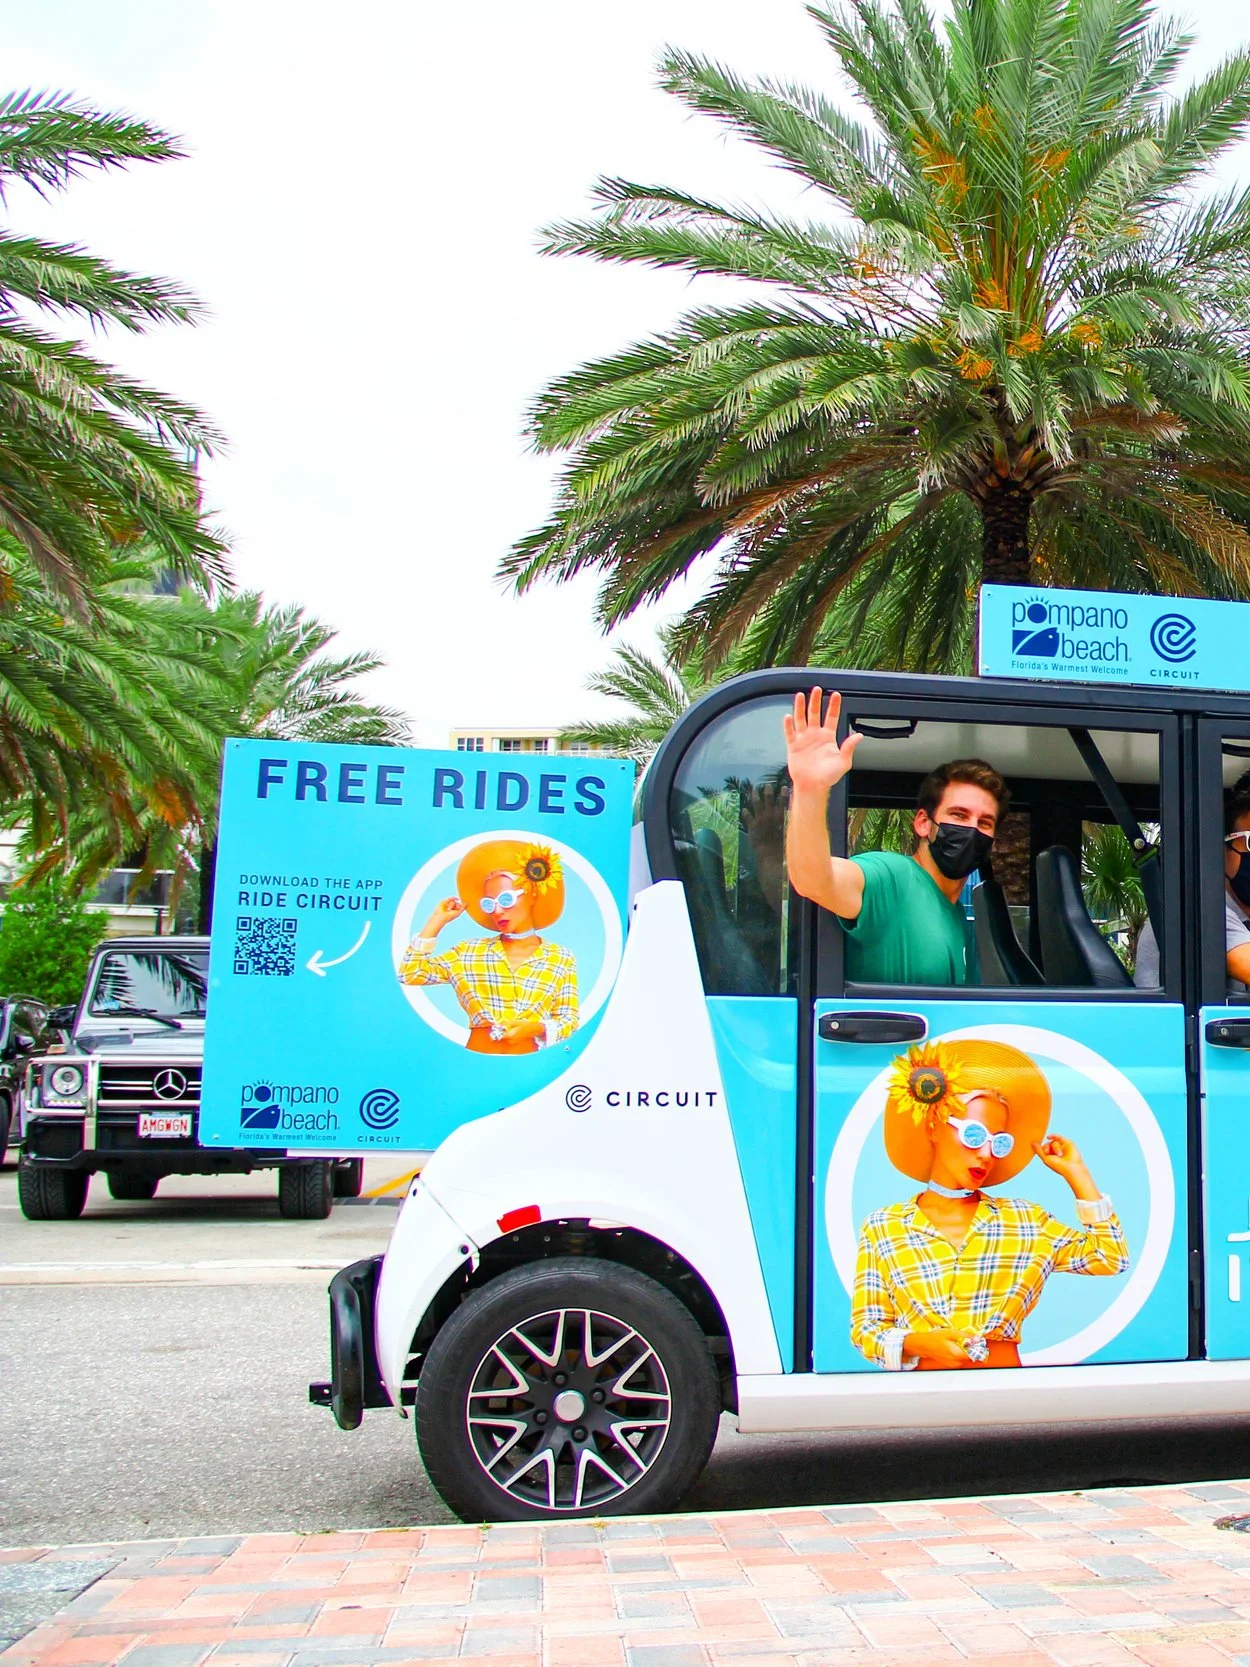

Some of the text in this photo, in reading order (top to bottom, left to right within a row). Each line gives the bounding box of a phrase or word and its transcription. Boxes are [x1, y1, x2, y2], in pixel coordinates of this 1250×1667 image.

[1012, 601, 1128, 631] pompano
[1061, 632, 1129, 662] beach
[1011, 661, 1128, 675] Florida's Warmest Welcome
[1150, 669, 1200, 680] CIRCUIT
[256, 758, 607, 816] FREE RIDES
[239, 874, 383, 890] DOWNLOAD THE APP
[238, 891, 383, 911] RIDE CIRCUIT
[241, 1084, 339, 1107] pompano
[606, 1091, 718, 1107] CIRCUIT
[142, 1119, 188, 1132] AMGWGN
[281, 1108, 339, 1130] beach
[238, 1132, 270, 1140] Florida's
[272, 1133, 304, 1141] Warmest
[357, 1135, 400, 1143] CIRCUIT
